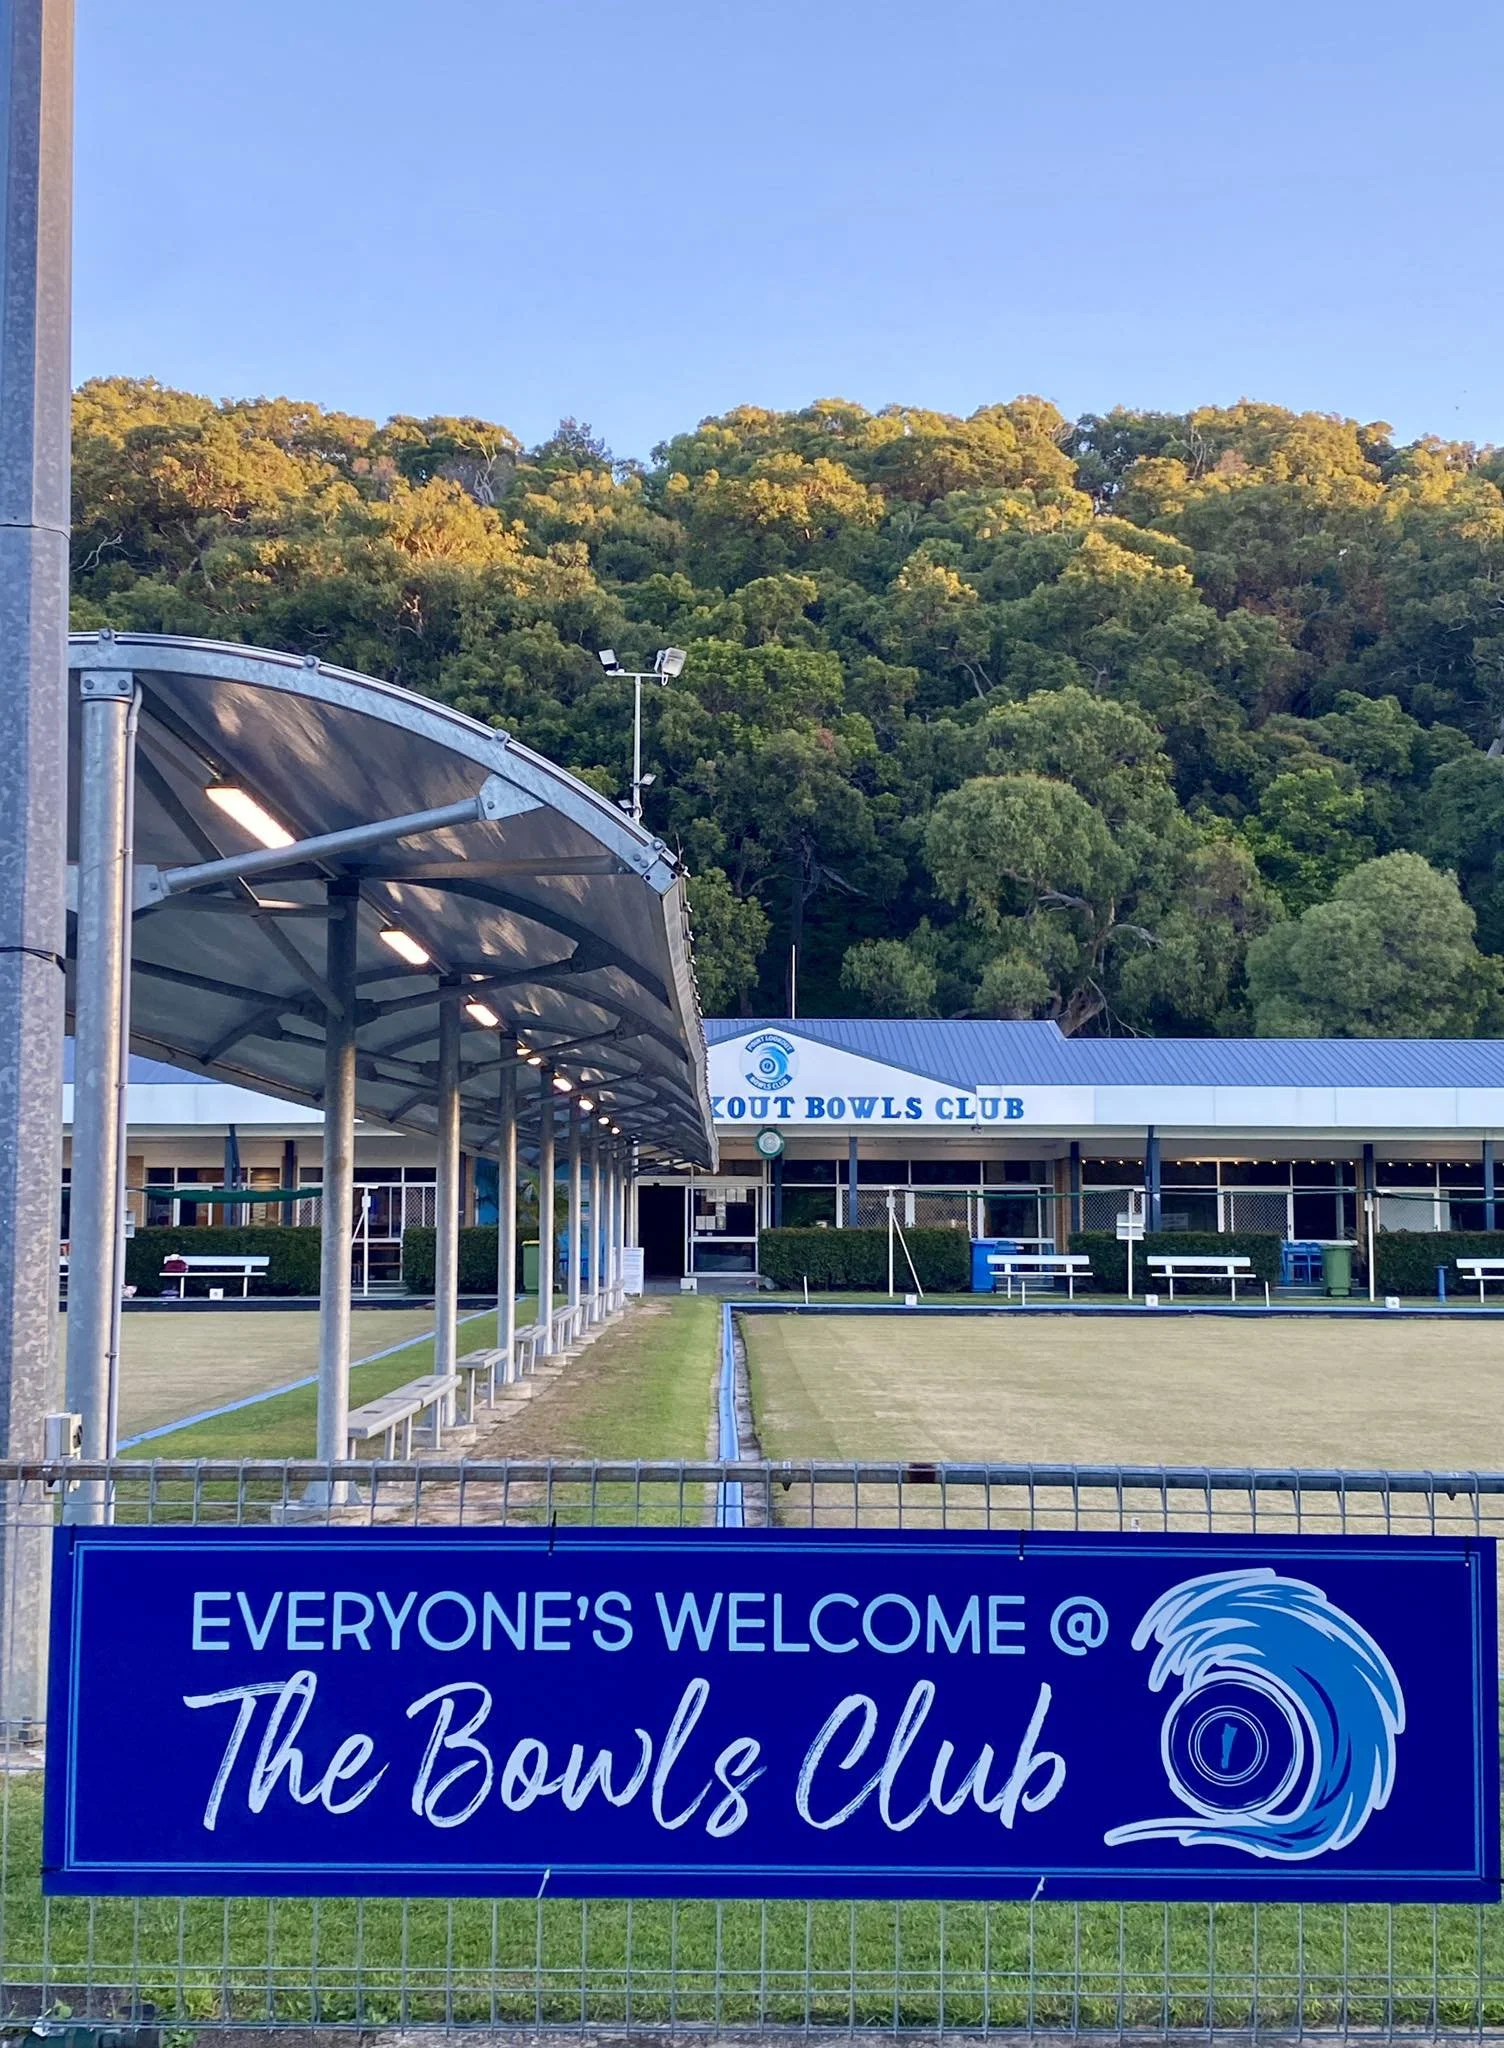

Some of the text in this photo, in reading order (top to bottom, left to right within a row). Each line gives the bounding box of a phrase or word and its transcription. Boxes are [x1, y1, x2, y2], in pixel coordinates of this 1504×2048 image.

[772, 1078, 789, 1090] CLUB
[804, 1096, 923, 1120] BOWLS
[934, 1096, 1025, 1120] CLUB
[192, 1590, 1110, 1658] EVERYONE'S WELCOME @
[182, 1669, 1068, 1839] The Bowls Club
